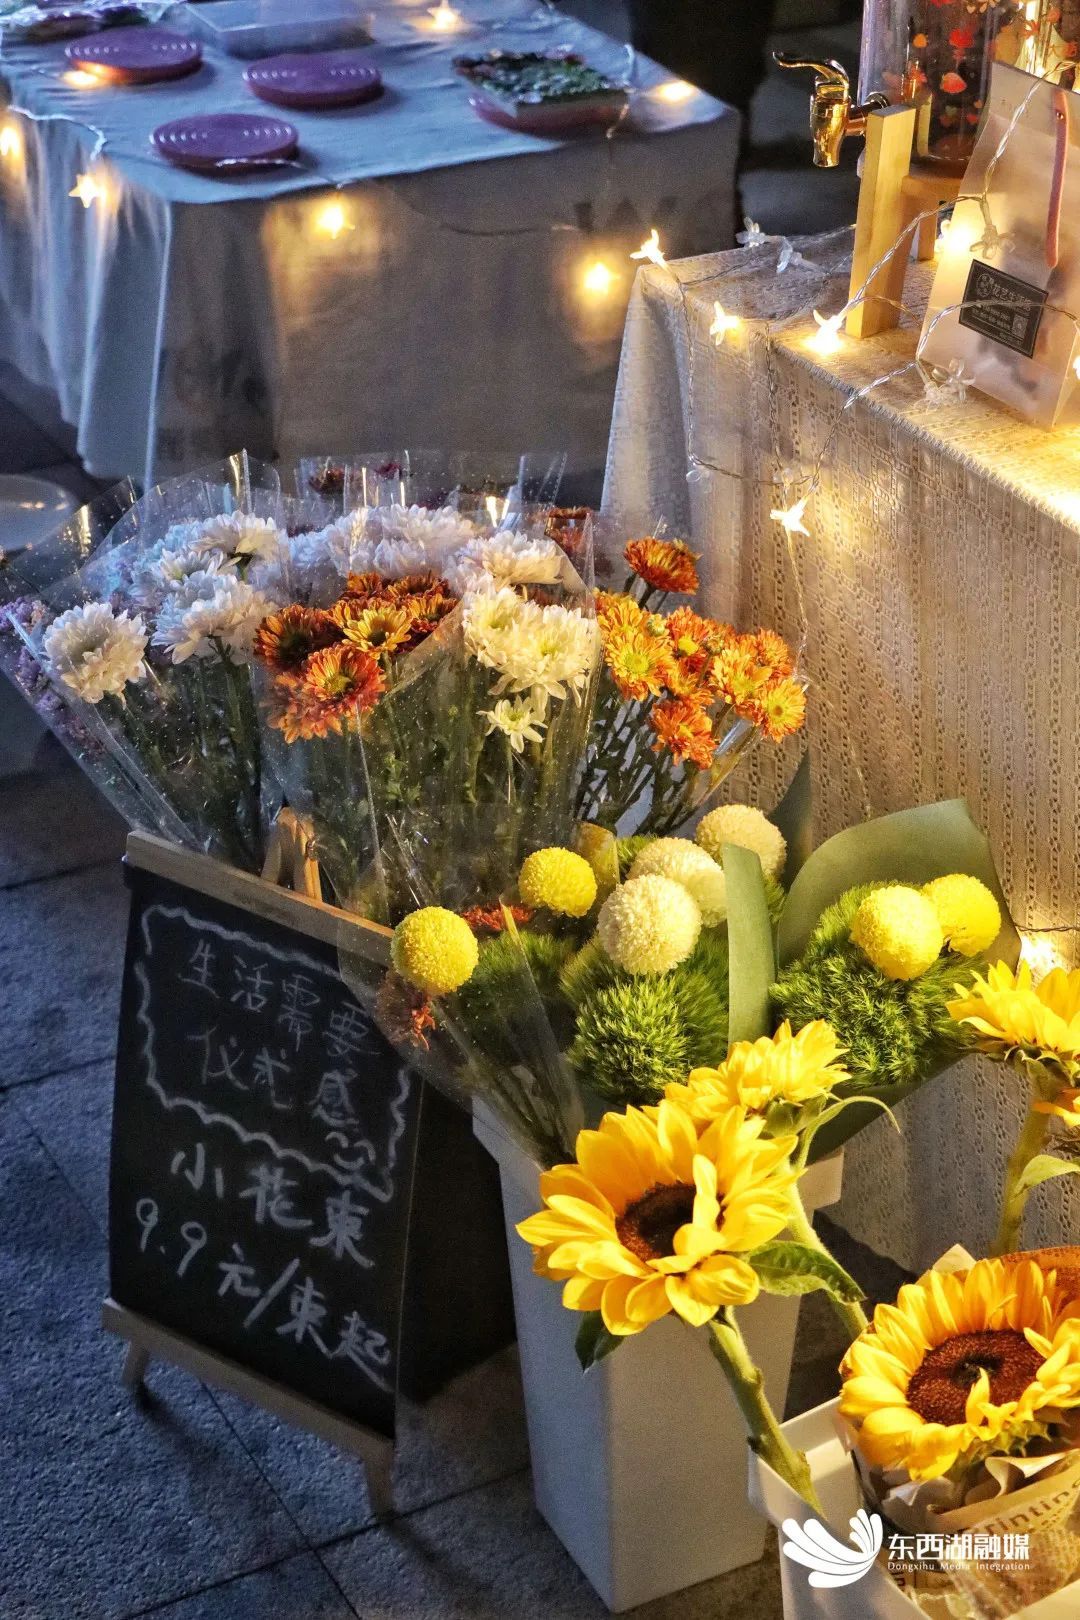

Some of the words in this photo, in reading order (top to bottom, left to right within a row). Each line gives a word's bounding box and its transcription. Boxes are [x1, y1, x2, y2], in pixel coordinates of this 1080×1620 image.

[177, 938, 381, 1056] 生活需要
[186, 1026, 360, 1128] 仪式感
[170, 1142, 376, 1268] 小花束
